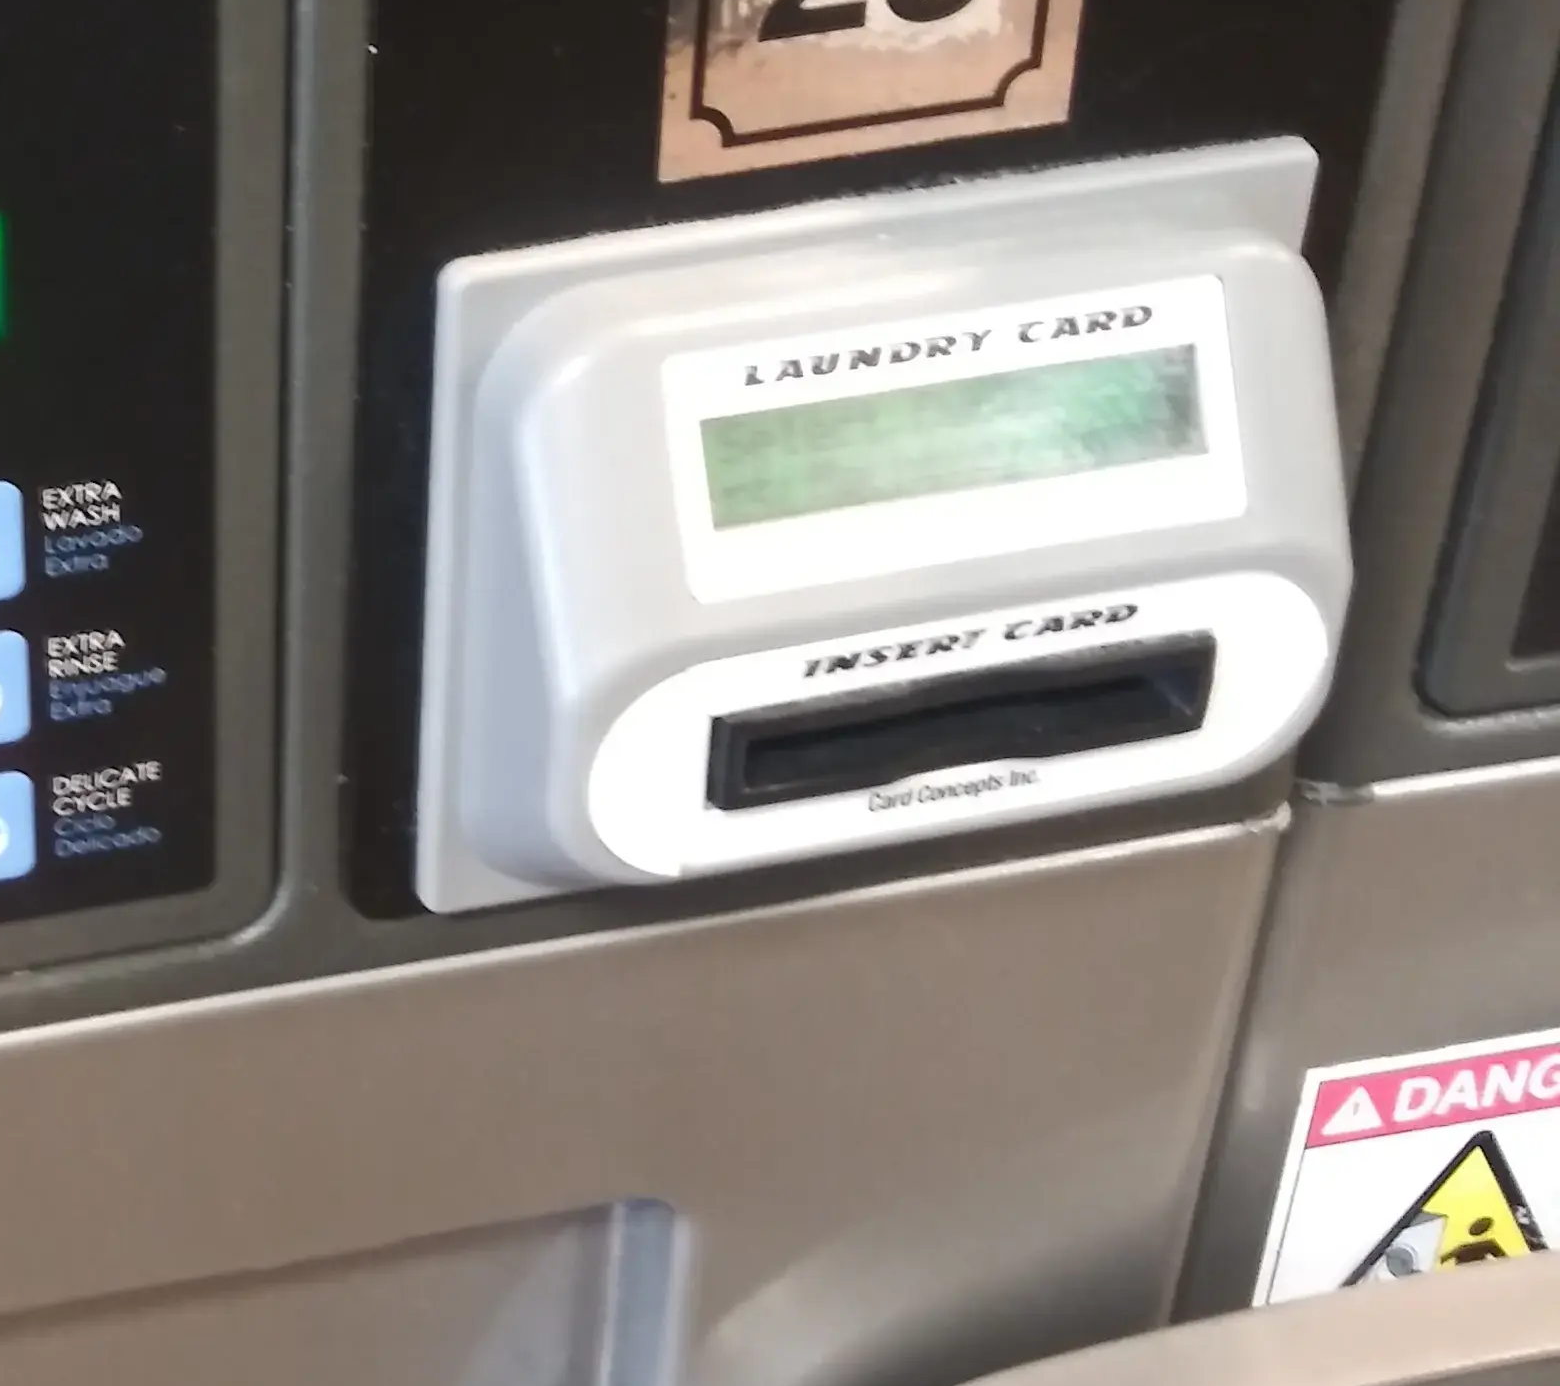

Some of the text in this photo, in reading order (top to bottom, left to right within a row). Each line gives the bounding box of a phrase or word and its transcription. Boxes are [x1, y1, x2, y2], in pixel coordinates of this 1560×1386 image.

[744, 305, 1154, 386] LAUNDRY CARD
[42, 479, 123, 511] EXTRA
[42, 502, 121, 531] WASH
[47, 629, 127, 659] EXTRA
[803, 603, 1139, 678] INSERT CARD
[48, 650, 120, 679] RINSE
[52, 760, 162, 796] DELICATE
[868, 789, 913, 813] Card
[917, 774, 1004, 805] Concepts
[52, 786, 133, 816] CYCLE
